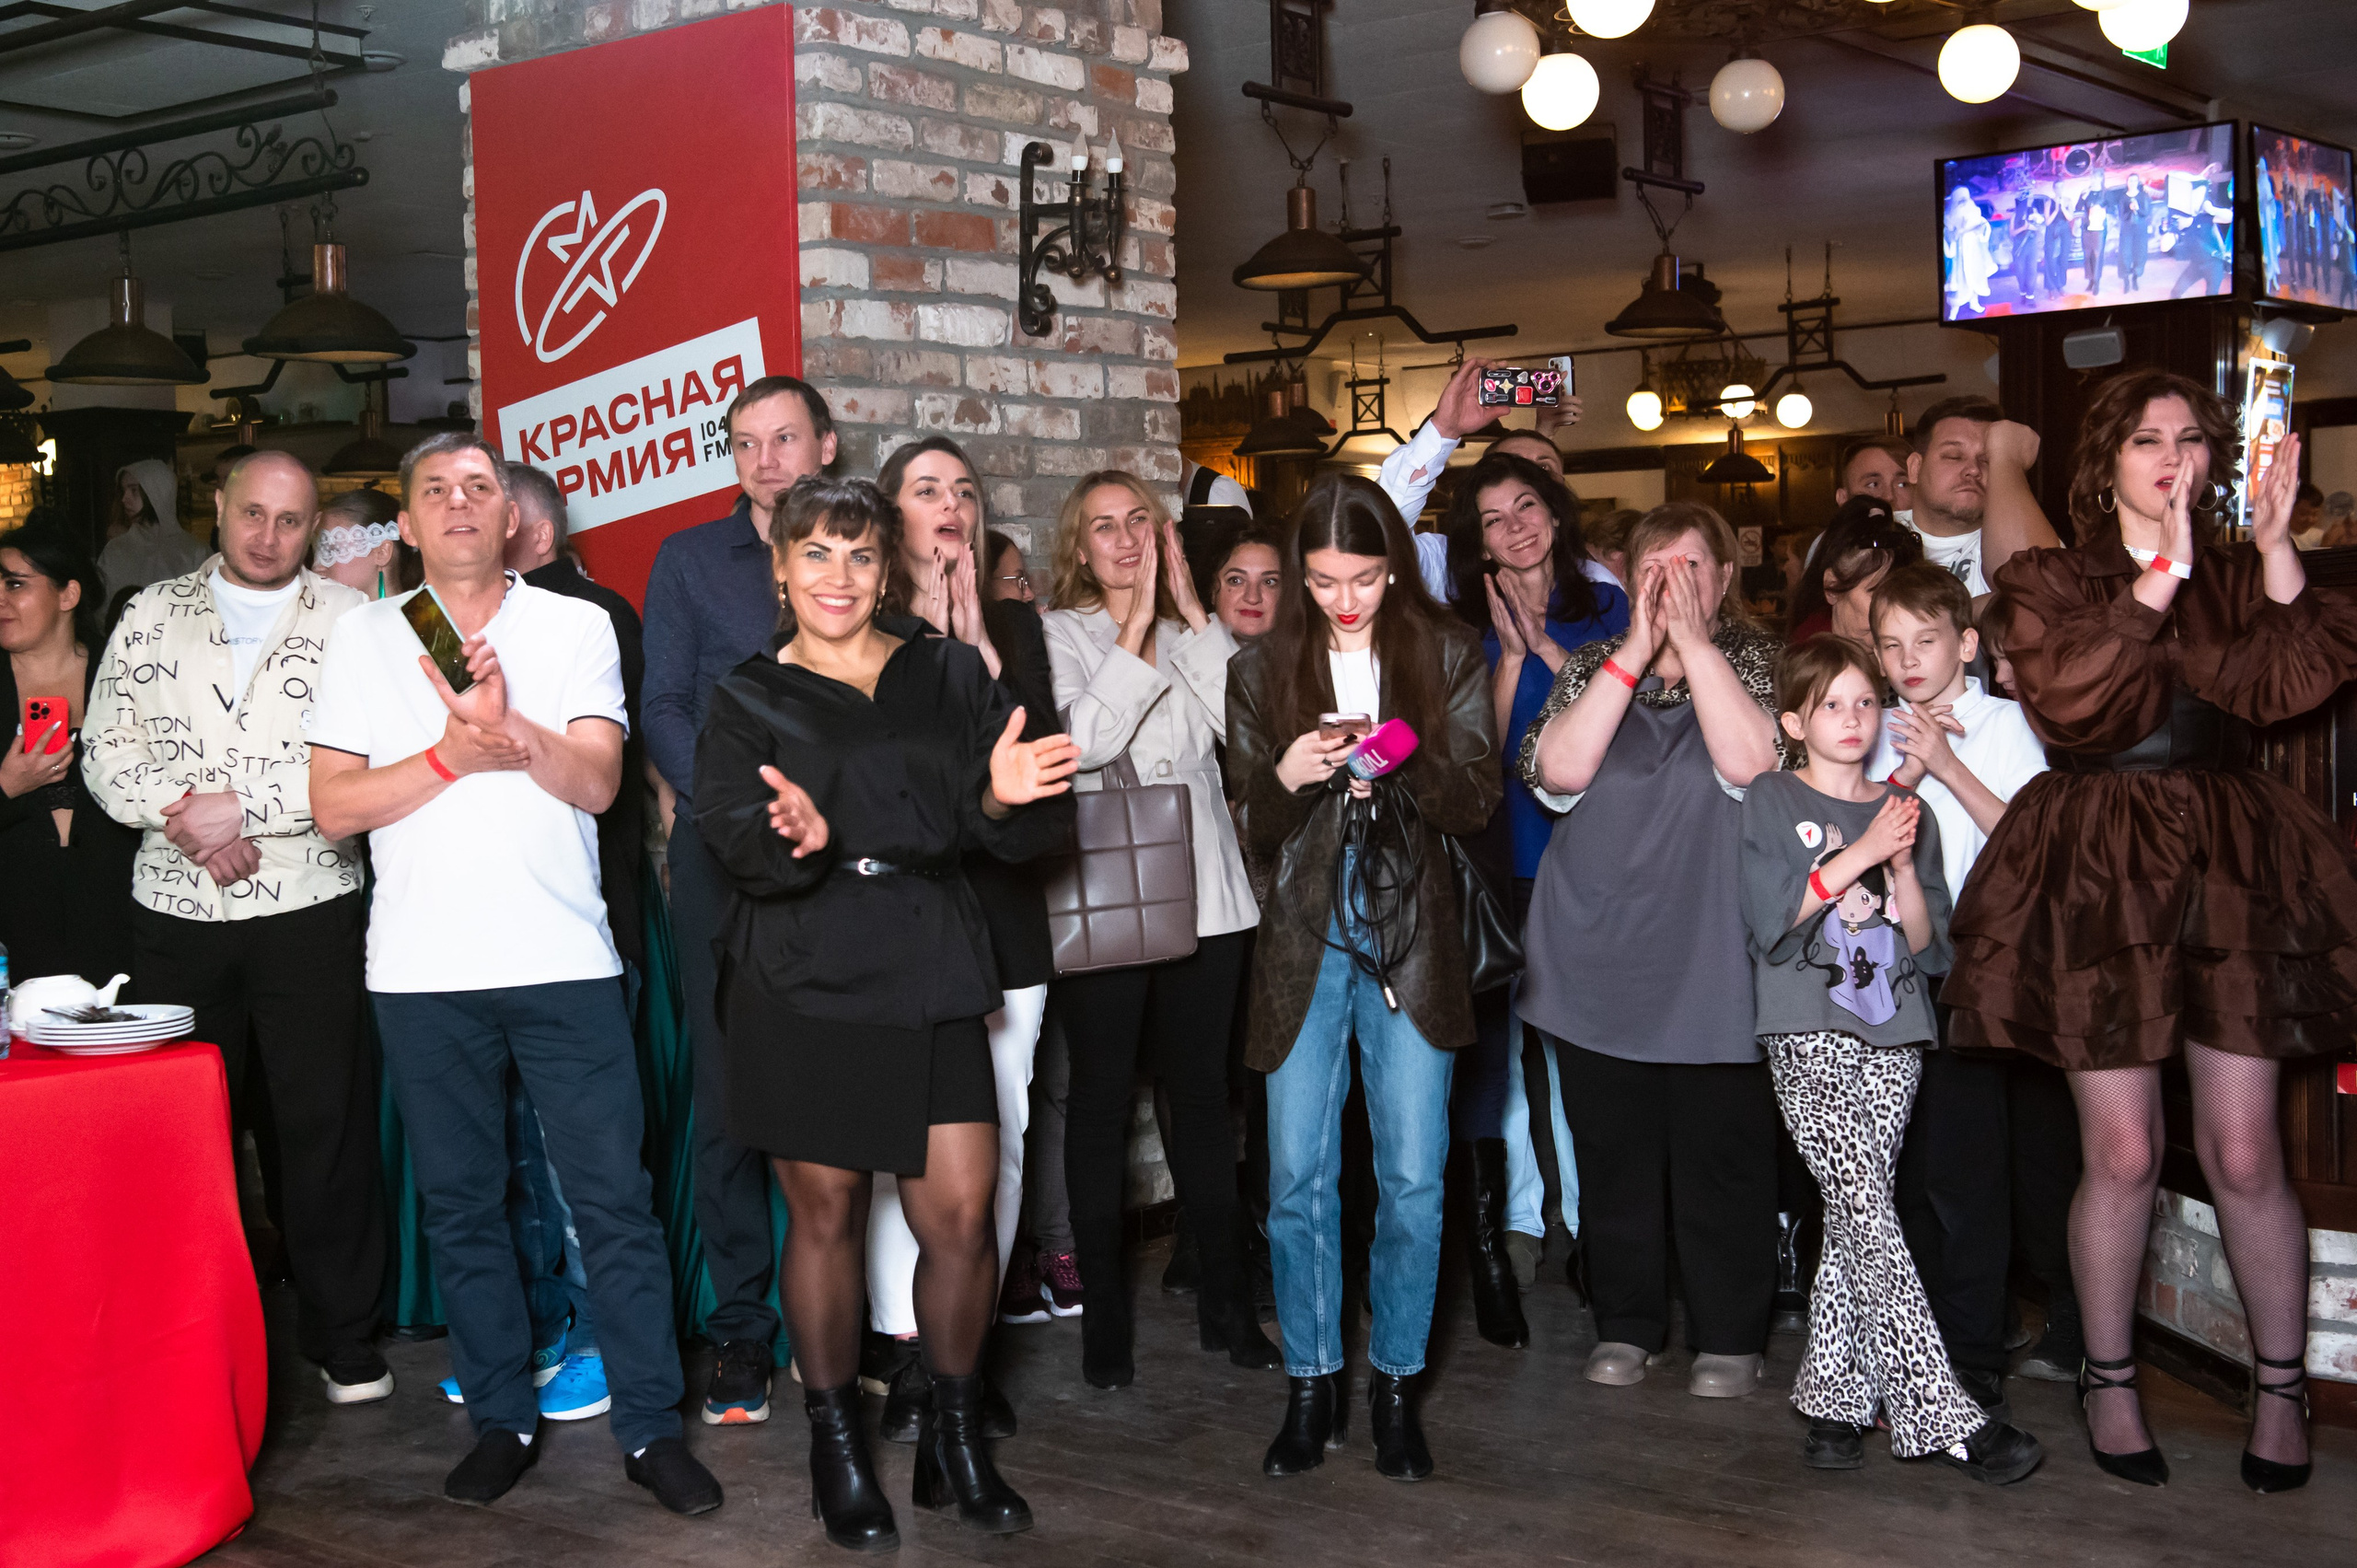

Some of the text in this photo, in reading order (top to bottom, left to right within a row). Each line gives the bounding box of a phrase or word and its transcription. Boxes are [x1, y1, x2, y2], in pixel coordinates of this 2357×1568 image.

[518, 354, 747, 465] КРАСНАЯ
[555, 426, 697, 506] РМИЯ
[703, 437, 732, 462] FM
[152, 890, 214, 919] TTON
